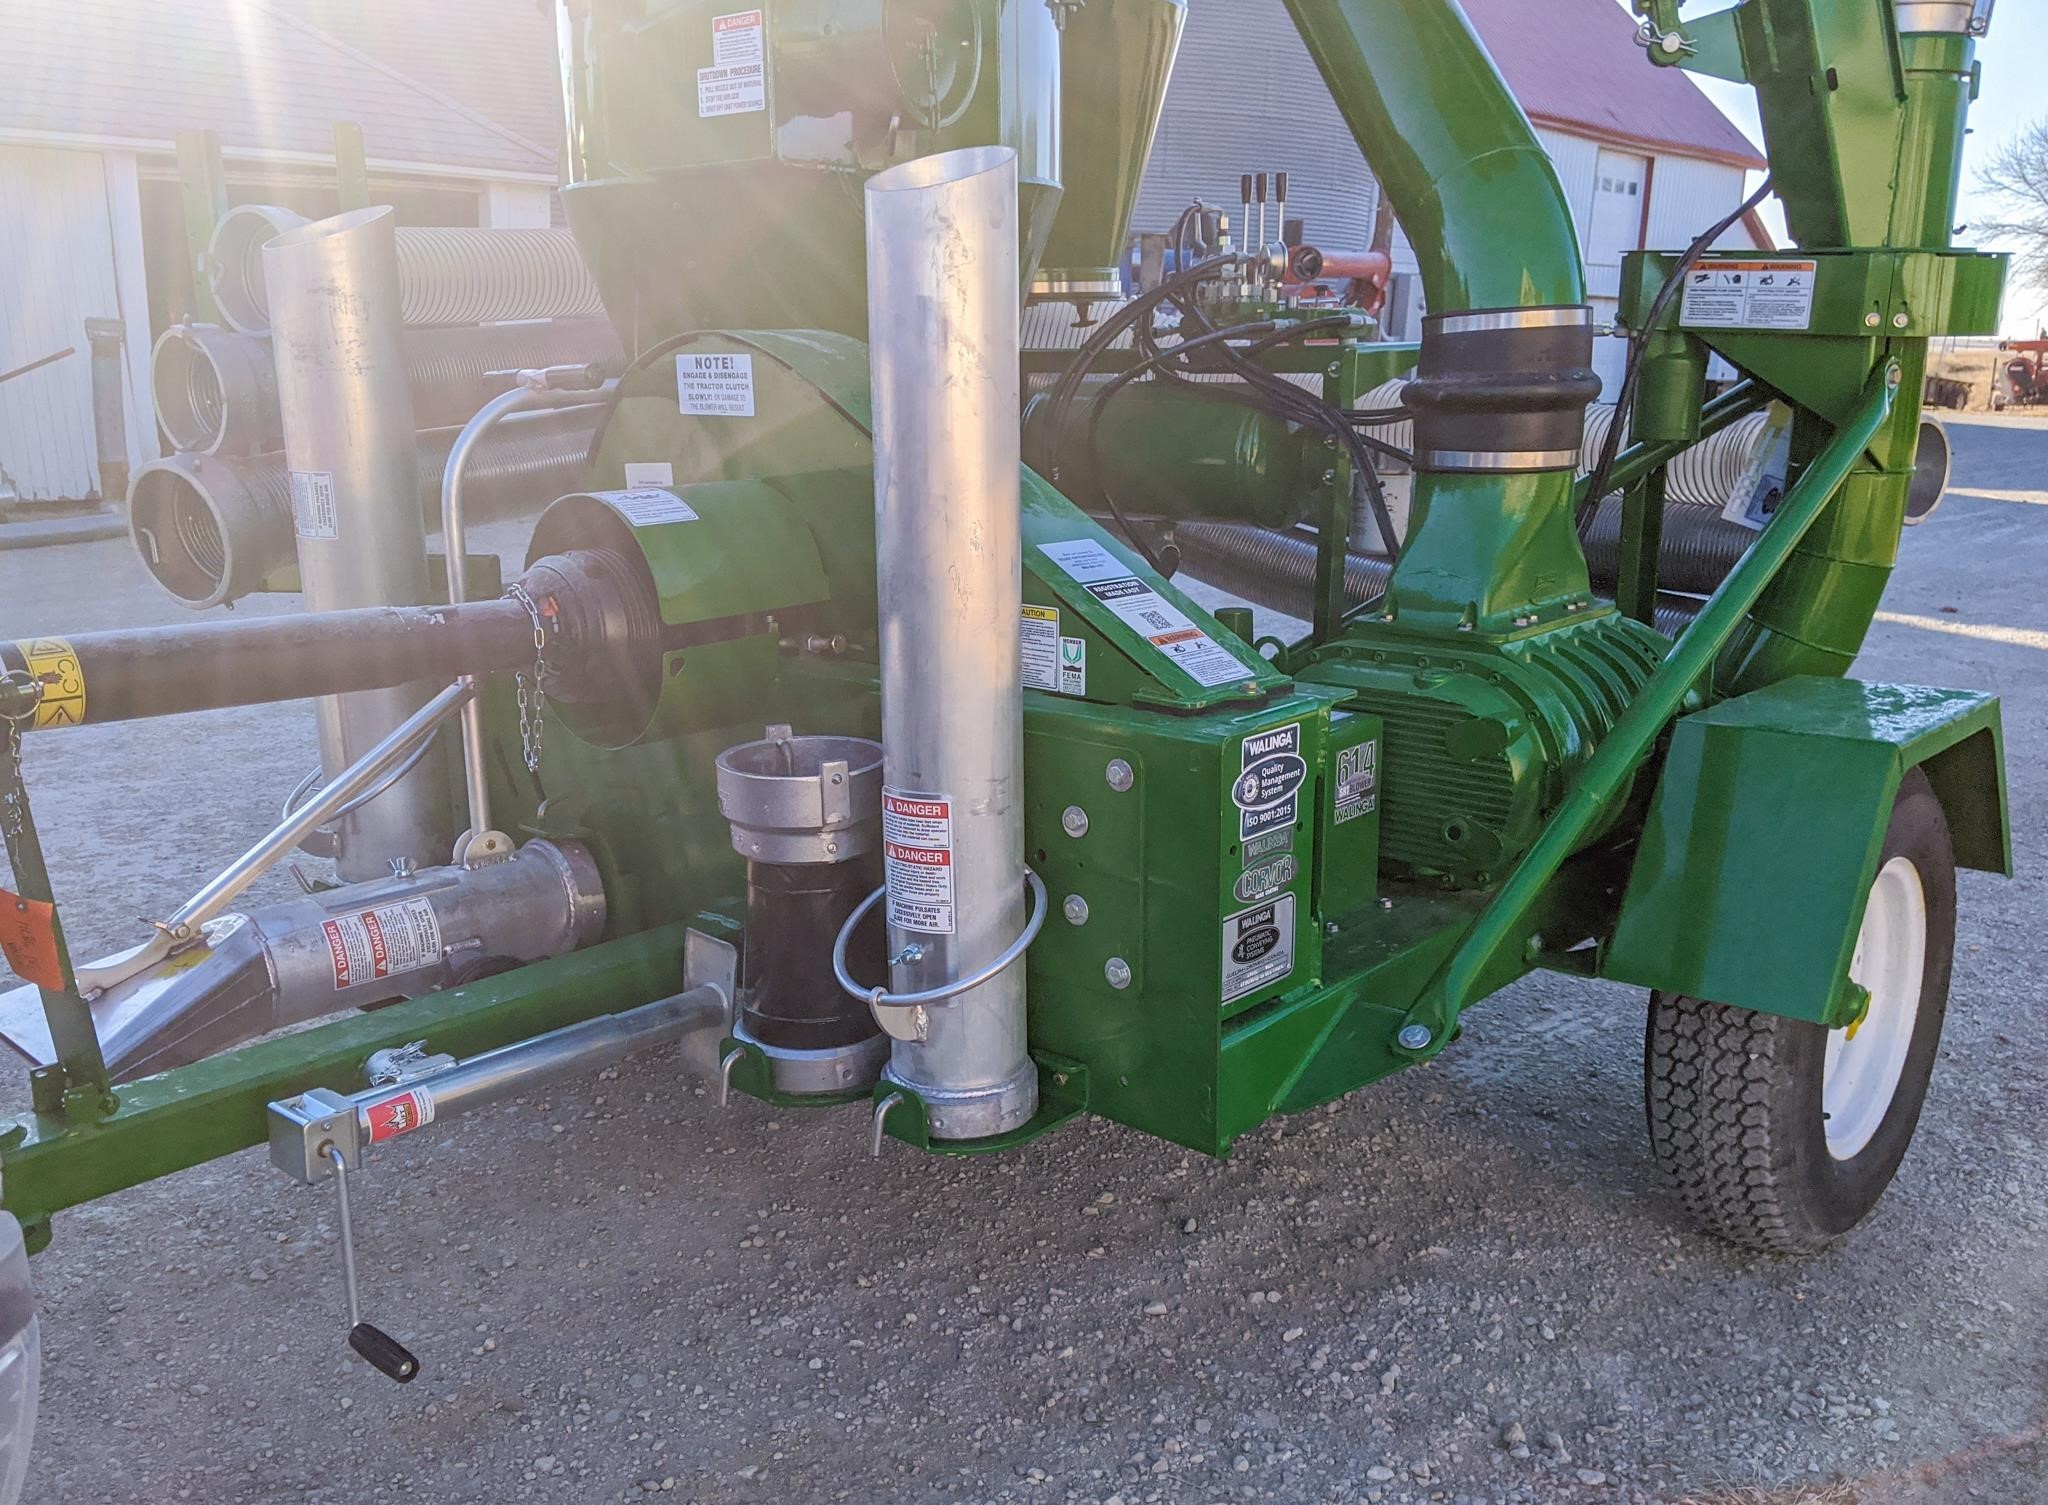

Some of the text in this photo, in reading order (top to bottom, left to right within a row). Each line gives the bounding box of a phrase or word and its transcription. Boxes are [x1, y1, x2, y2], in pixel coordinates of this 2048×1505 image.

[727, 15, 756, 27] DANGER
[700, 64, 761, 81] SHUTDOWN PROCEDURE
[695, 356, 734, 370] NOTE!
[725, 383, 750, 391] CLUTCH
[688, 393, 713, 401] SLOWLY!
[690, 403, 699, 411] THE
[699, 403, 718, 411] BLOWER
[729, 404, 745, 412] RESULT
[1093, 581, 1139, 593] REGISTRATION
[1105, 587, 1141, 598] MADE EASY
[1021, 608, 1045, 618] AUTION
[1062, 671, 1081, 680] FEMA
[1249, 731, 1293, 756] WALINGA
[1261, 763, 1285, 777] Quality
[1336, 741, 1376, 789] 614
[1261, 768, 1301, 788] Management
[1349, 777, 1372, 794] BLOWER
[1260, 785, 1284, 800] System
[896, 801, 941, 816] DANGER
[1247, 804, 1291, 828] ISO 9001:2015
[1335, 798, 1374, 825] WALINGA
[1248, 832, 1288, 857] WALINGA
[898, 849, 943, 863] DANGER
[1242, 854, 1292, 897] CORVOR
[895, 901, 914, 911] MACHINE
[915, 906, 941, 914] PULSATES
[895, 908, 921, 919] EXCESSIVELY,
[1241, 910, 1272, 929] WALINGA
[367, 915, 385, 959] DANGER
[417, 930, 426, 952] MACHINE
[1246, 929, 1273, 944] PNEUMATIC
[1246, 936, 1273, 951] CONVEYING
[327, 925, 347, 968] DANGER
[1246, 947, 1265, 960] SYSTEMS
